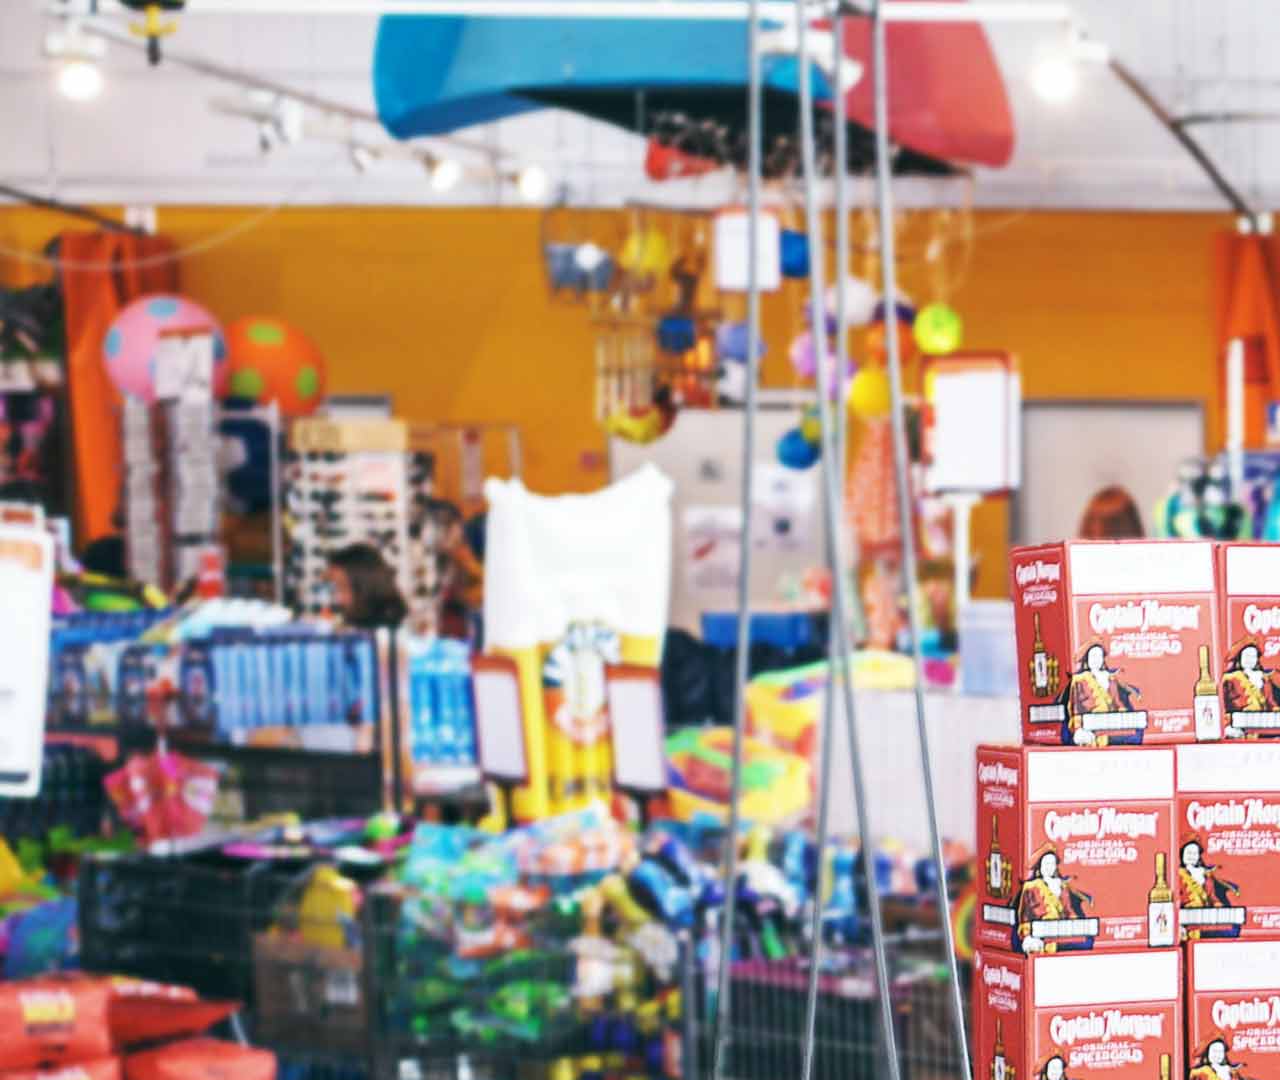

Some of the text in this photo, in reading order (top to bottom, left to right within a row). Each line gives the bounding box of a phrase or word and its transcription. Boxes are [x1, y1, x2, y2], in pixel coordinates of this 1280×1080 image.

[1090, 600, 1199, 633] Captain Morgan
[1150, 640, 1182, 654] GOLD
[1044, 807, 1158, 841] Captain Morgan
[1187, 800, 1245, 831] Captain
[1104, 847, 1137, 862] GOLD
[1050, 1010, 1164, 1045] Captain Morgan
[1212, 997, 1270, 1029] Captain
[1111, 1049, 1144, 1064] GOLD
